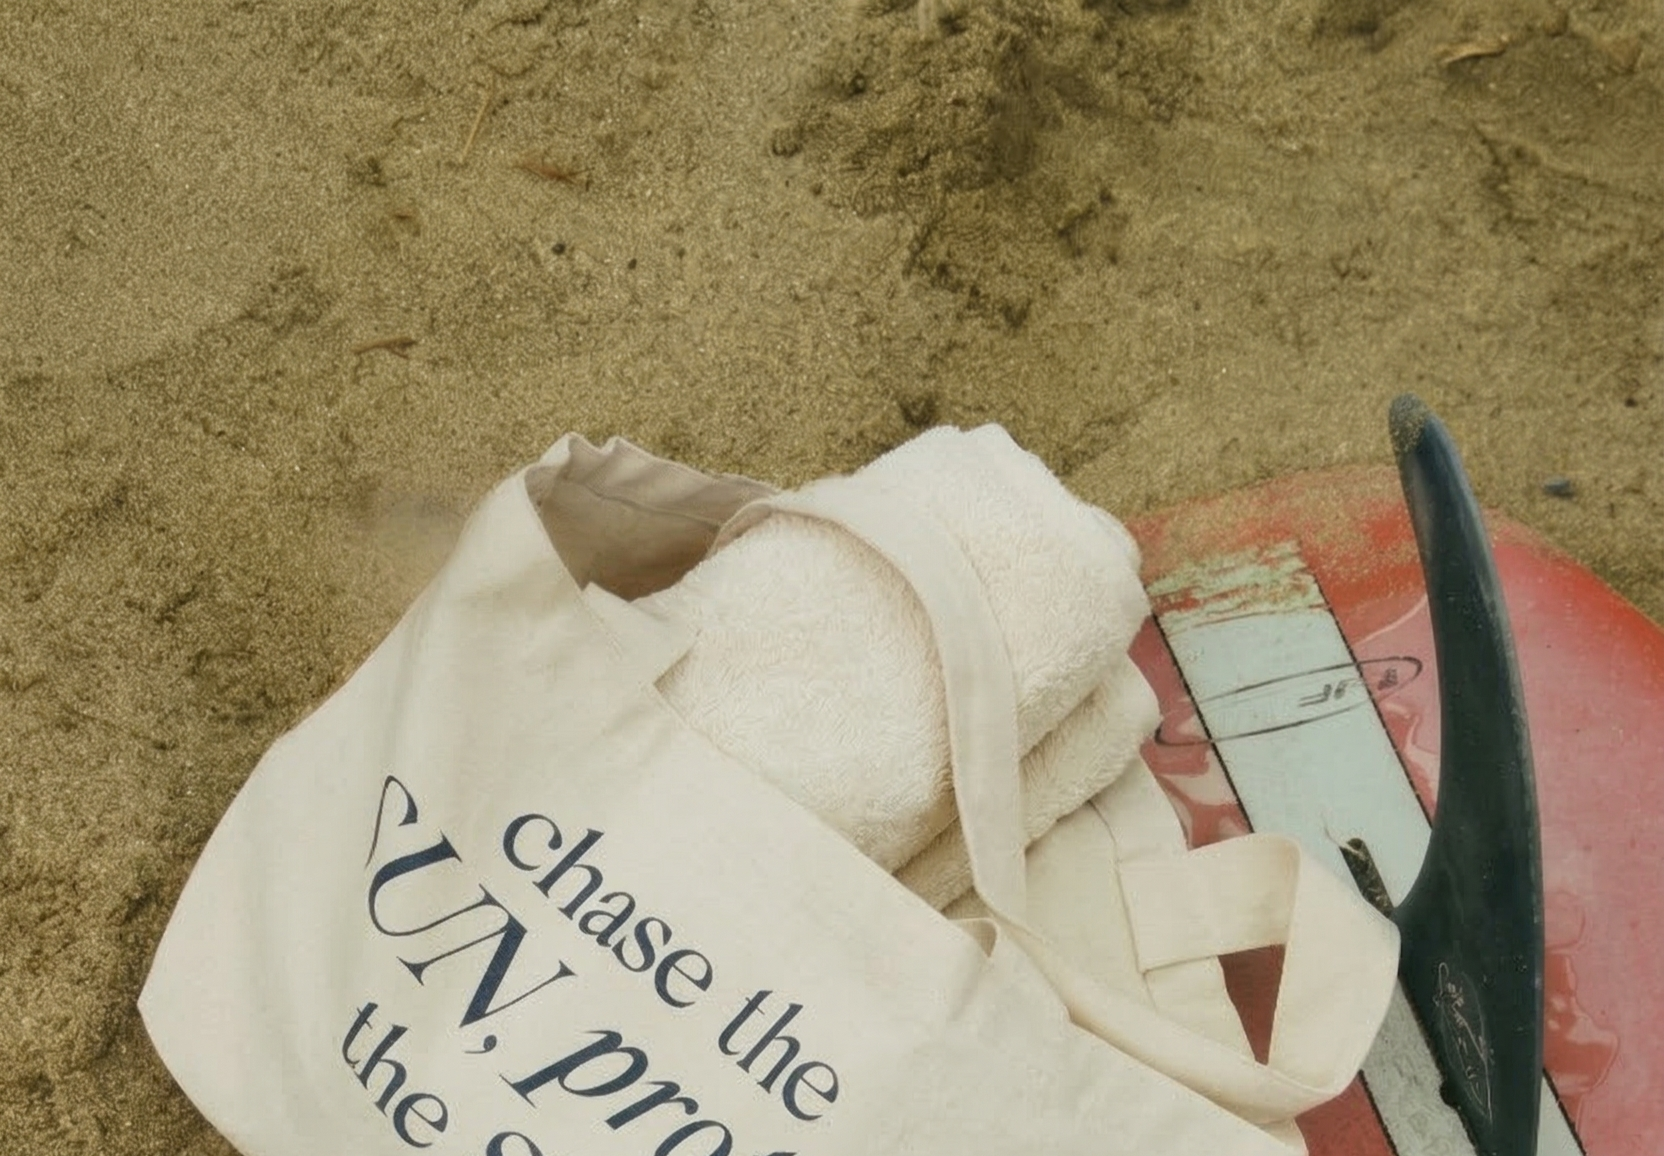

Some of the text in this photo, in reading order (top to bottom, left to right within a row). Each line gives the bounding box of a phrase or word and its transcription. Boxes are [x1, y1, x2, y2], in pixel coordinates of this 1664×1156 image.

[341, 1001, 449, 1149] the
[502, 813, 839, 1122] chase the
